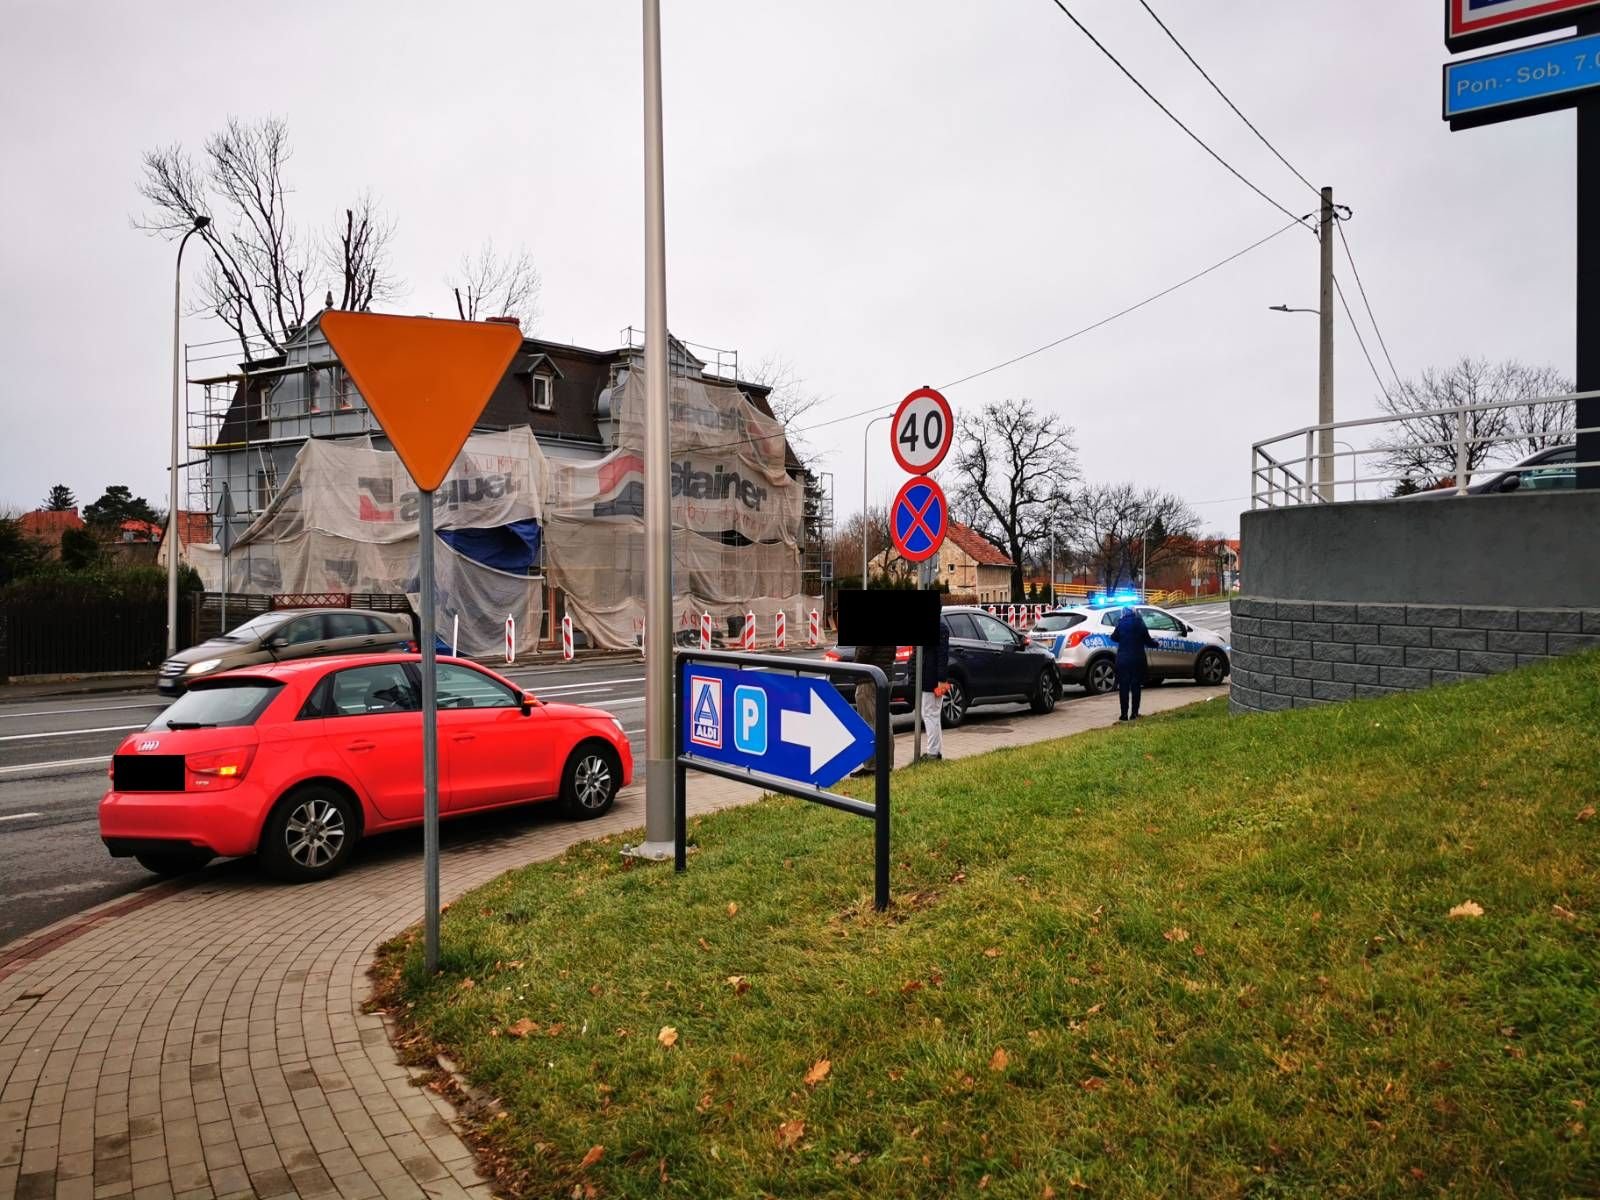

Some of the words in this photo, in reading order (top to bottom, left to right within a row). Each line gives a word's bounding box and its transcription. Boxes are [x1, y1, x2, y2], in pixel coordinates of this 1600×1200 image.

[899, 410, 943, 452] 40
[1158, 638, 1185, 650] POLICJA
[695, 725, 717, 740] ALDI
[742, 698, 760, 741] P
